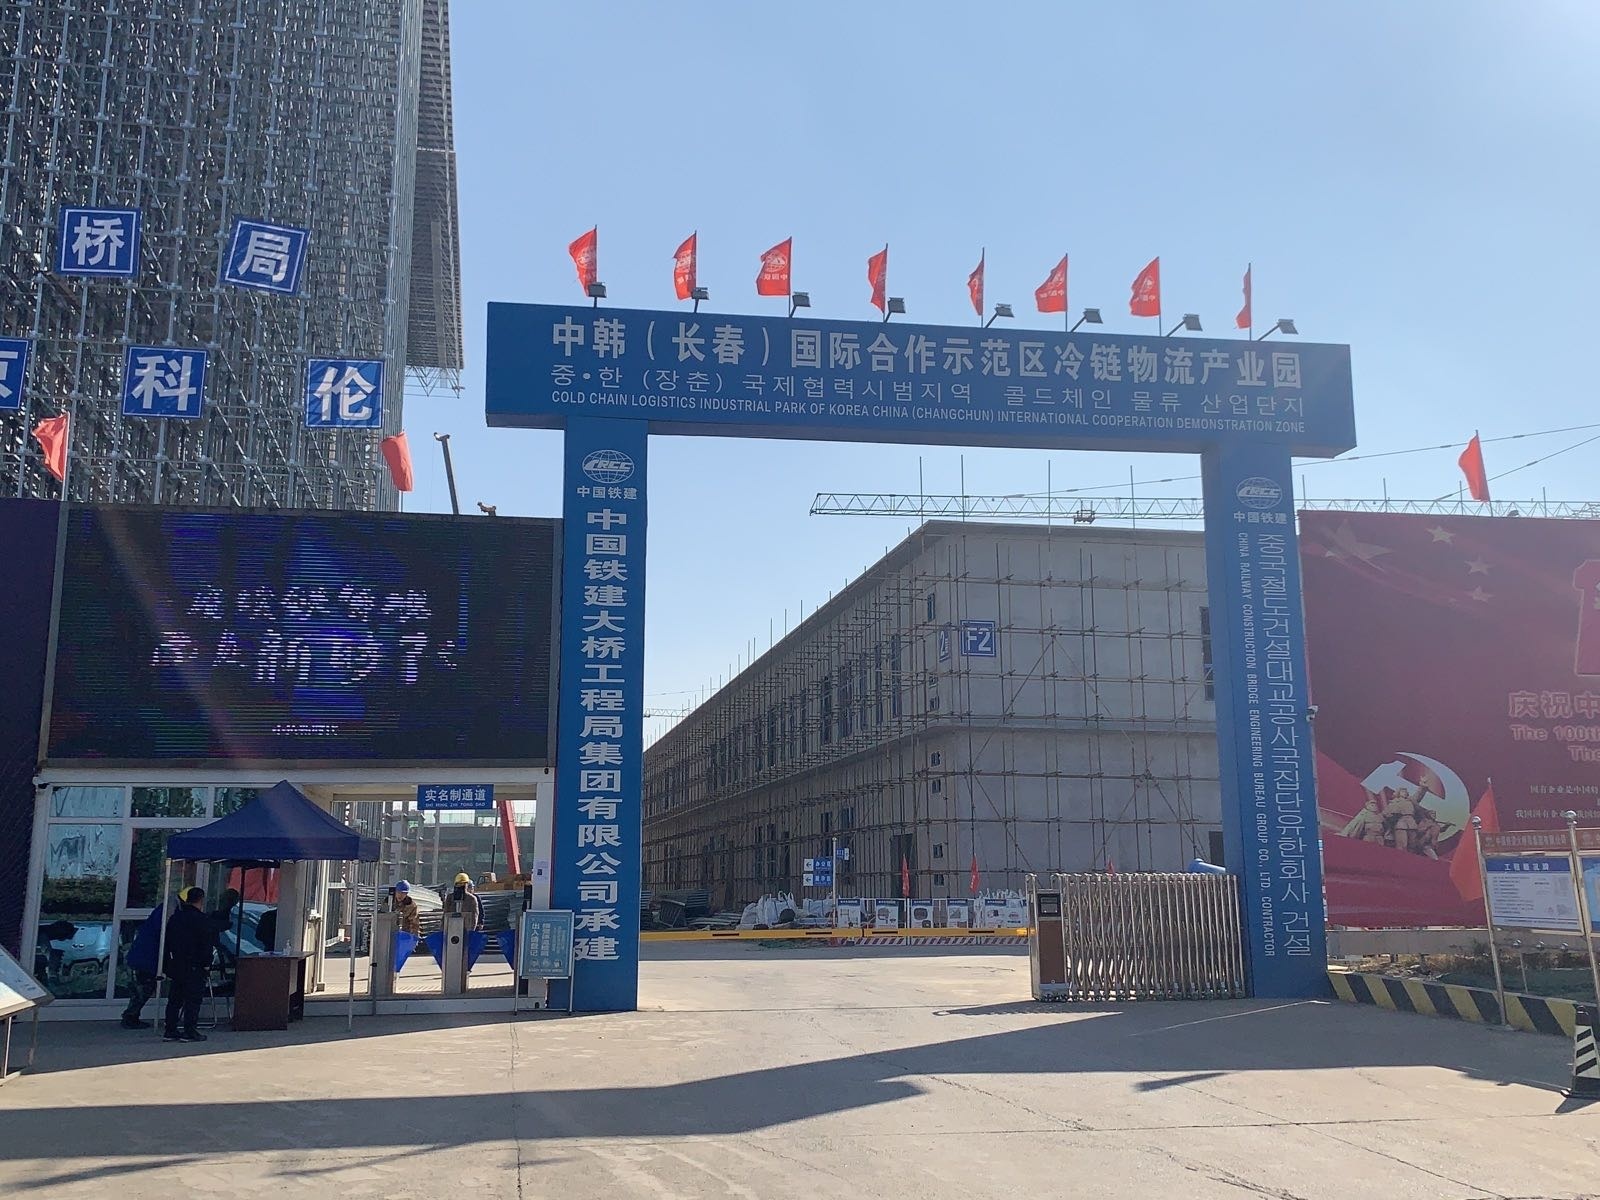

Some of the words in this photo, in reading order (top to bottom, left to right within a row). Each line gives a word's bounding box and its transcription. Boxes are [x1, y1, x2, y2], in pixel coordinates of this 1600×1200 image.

[71, 215, 125, 268] 桥
[236, 229, 291, 284] 局
[131, 354, 197, 411] 科
[312, 366, 376, 422] 伦
[1003, 385, 1112, 410] 콜드체인
[1131, 391, 1182, 413] 물류
[1200, 394, 1304, 417] 산업단지
[551, 390, 586, 404] COLD
[589, 393, 628, 406] CHAIN
[631, 394, 697, 409] LOGISTICS
[700, 398, 771, 413] INDUSTRIAL
[775, 401, 807, 415] PARK
[810, 403, 826, 415] OF
[829, 403, 869, 417] KOREA
[872, 405, 909, 418] CHINA
[912, 406, 994, 423] (CHANGCHUN)
[997, 411, 1089, 425] INTERNATIONAL
[1092, 414, 1173, 429] COOPERATION
[1176, 417, 1272, 432] DEMONSTRATION
[1275, 420, 1305, 433] ZONE
[576, 485, 638, 500] 中国铁建
[1233, 511, 1288, 524] 中国铁建
[1238, 532, 1249, 558] CHINA
[1240, 562, 1252, 600] RAILWAY
[967, 627, 992, 652] F2
[1242, 604, 1257, 672] CONSTRUCTION
[1247, 674, 1259, 704] BRIDGE
[574, 508, 628, 961] 中国铁建大桥工程局集团有限公司承建
[1249, 709, 1263, 767] ENGINEERING
[1510, 724, 1549, 741] The
[425, 788, 487, 801] 实名制通道
[1254, 772, 1267, 808] BUREAU
[1256, 813, 1268, 844] GROUP
[1261, 897, 1276, 956] CONTRACTOR
[1282, 911, 1312, 956] 건설
